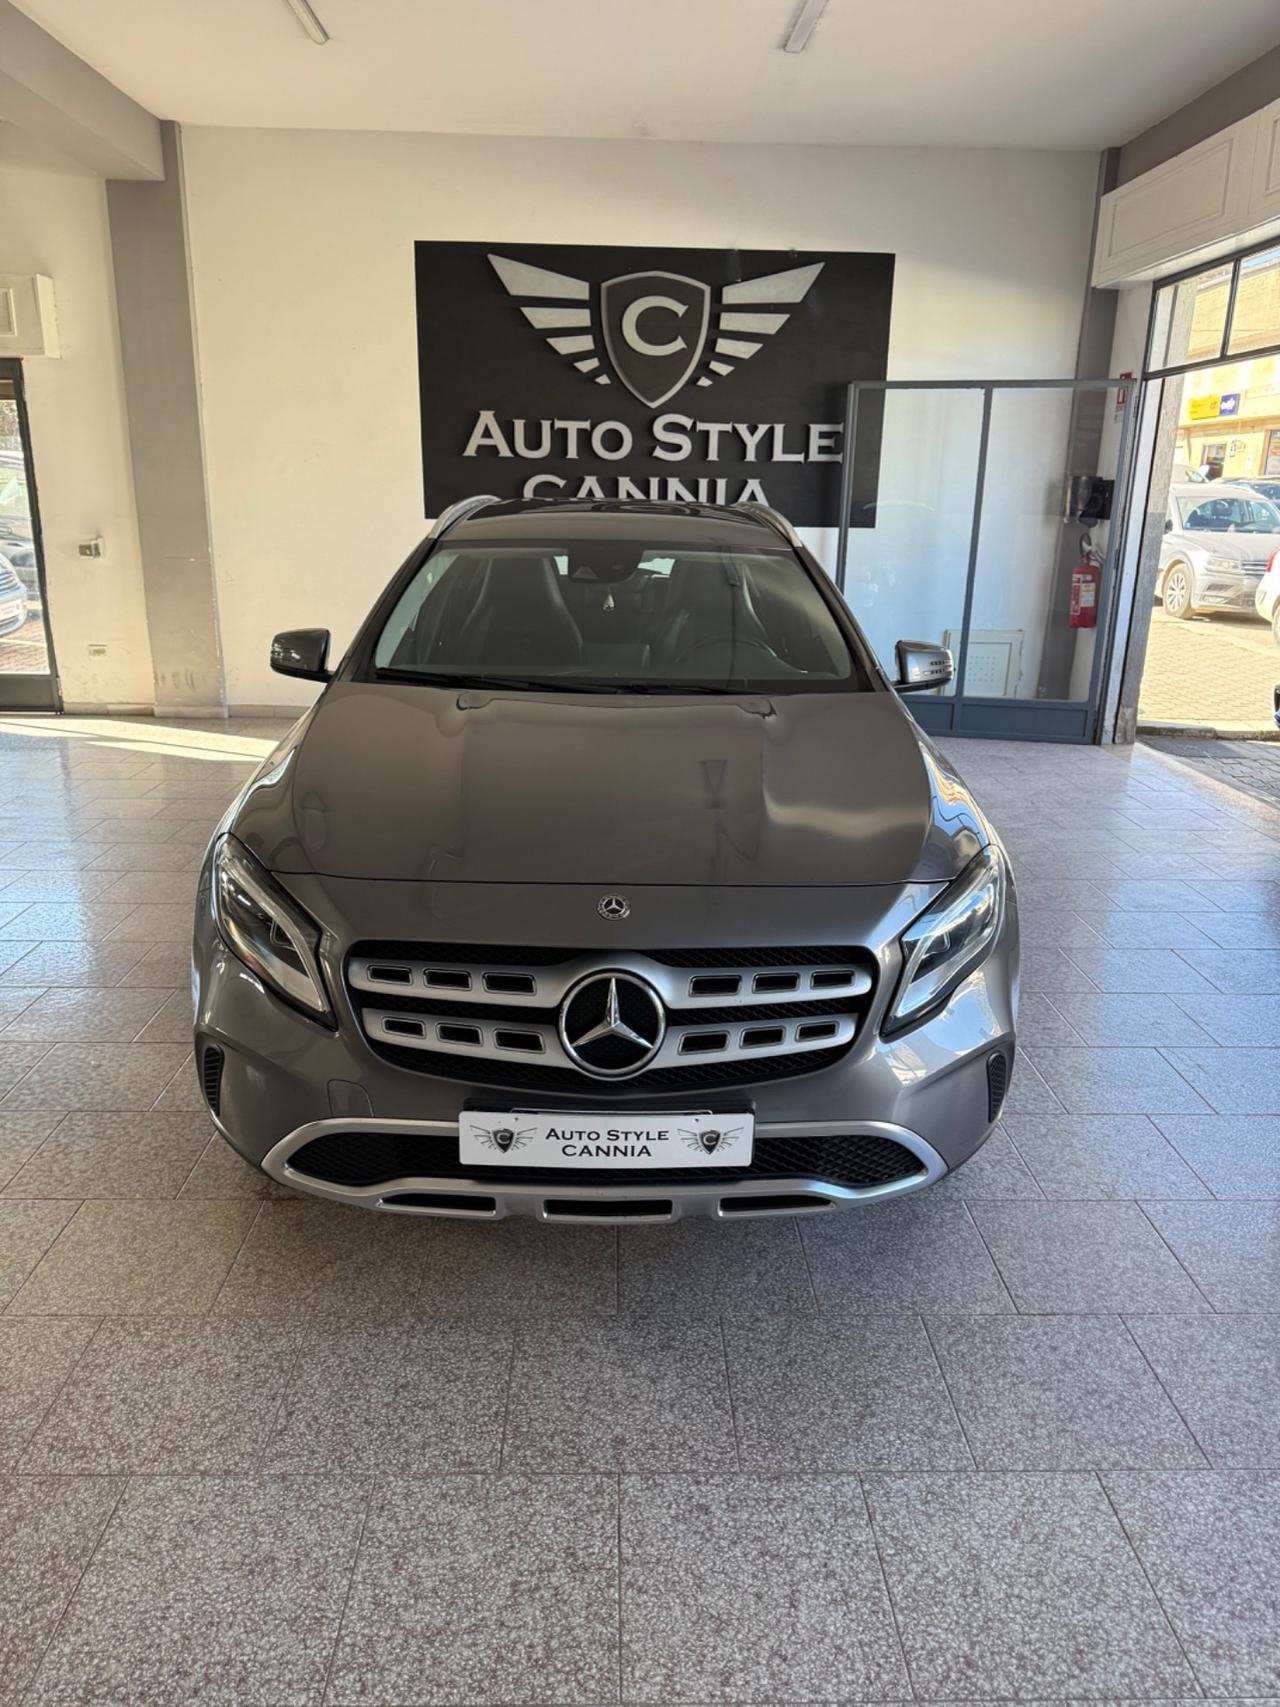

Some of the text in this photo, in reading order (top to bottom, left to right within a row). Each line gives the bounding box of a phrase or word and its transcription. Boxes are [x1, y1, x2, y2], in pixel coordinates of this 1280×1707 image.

[621, 295, 689, 356] C
[463, 410, 844, 464] AUTO STYLE
[545, 1128, 670, 1141] AUTO STYLE
[561, 1144, 652, 1158] CANNIA
